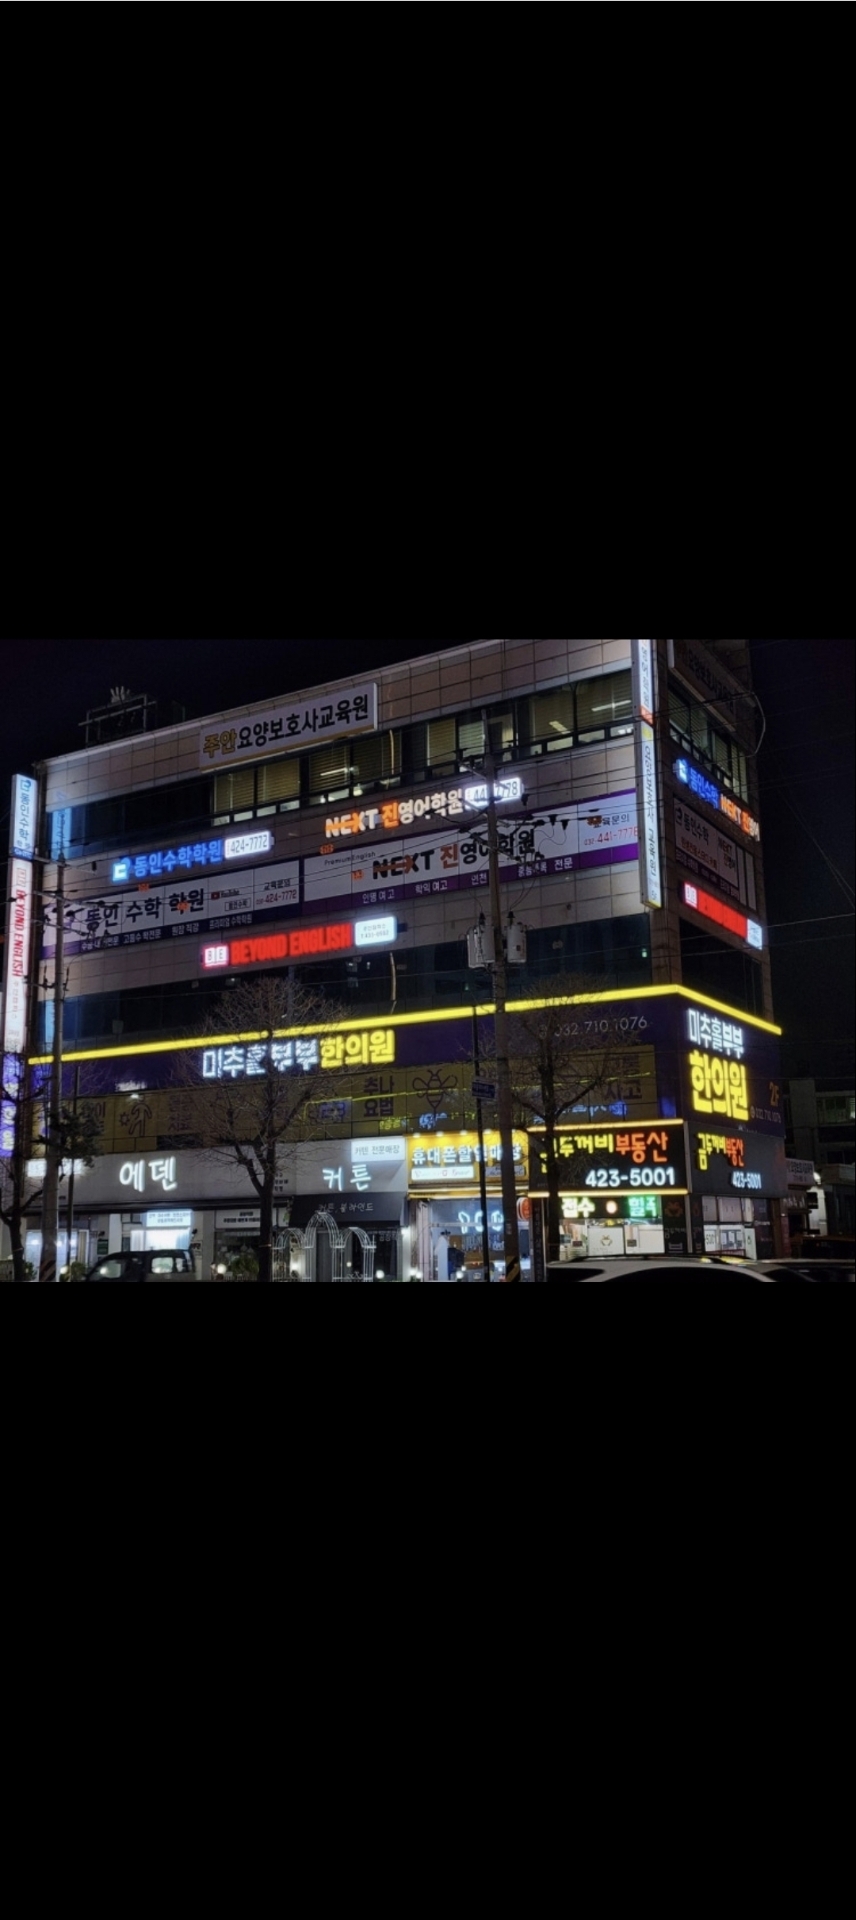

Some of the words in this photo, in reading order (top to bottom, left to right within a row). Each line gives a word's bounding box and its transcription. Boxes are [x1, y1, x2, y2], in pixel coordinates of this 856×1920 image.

[325, 809, 379, 838] NEXT
[382, 789, 463, 829] 진영어학원
[134, 838, 223, 878] 동인수학학원
[230, 834, 268, 854] 424-7772
[325, 856, 351, 865] Premium
[352, 851, 376, 861] English
[373, 850, 434, 879] NEXT
[555, 857, 573, 871] 전문
[14, 890, 25, 934] BEYOND
[126, 896, 161, 923] 수학
[169, 888, 204, 915] 학원
[12, 935, 24, 977] ENGLISH
[230, 933, 287, 966] BEYOND
[289, 921, 353, 957] ENGLISH
[688, 1008, 744, 1059] 미추홀부부
[364, 1075, 394, 1098] 추나
[689, 1050, 749, 1121] 한의원
[119, 1155, 177, 1192] 에덴
[322, 1164, 371, 1191] 커튼
[585, 1167, 675, 1188] 423-5001
[732, 1170, 762, 1189] 423-5001
